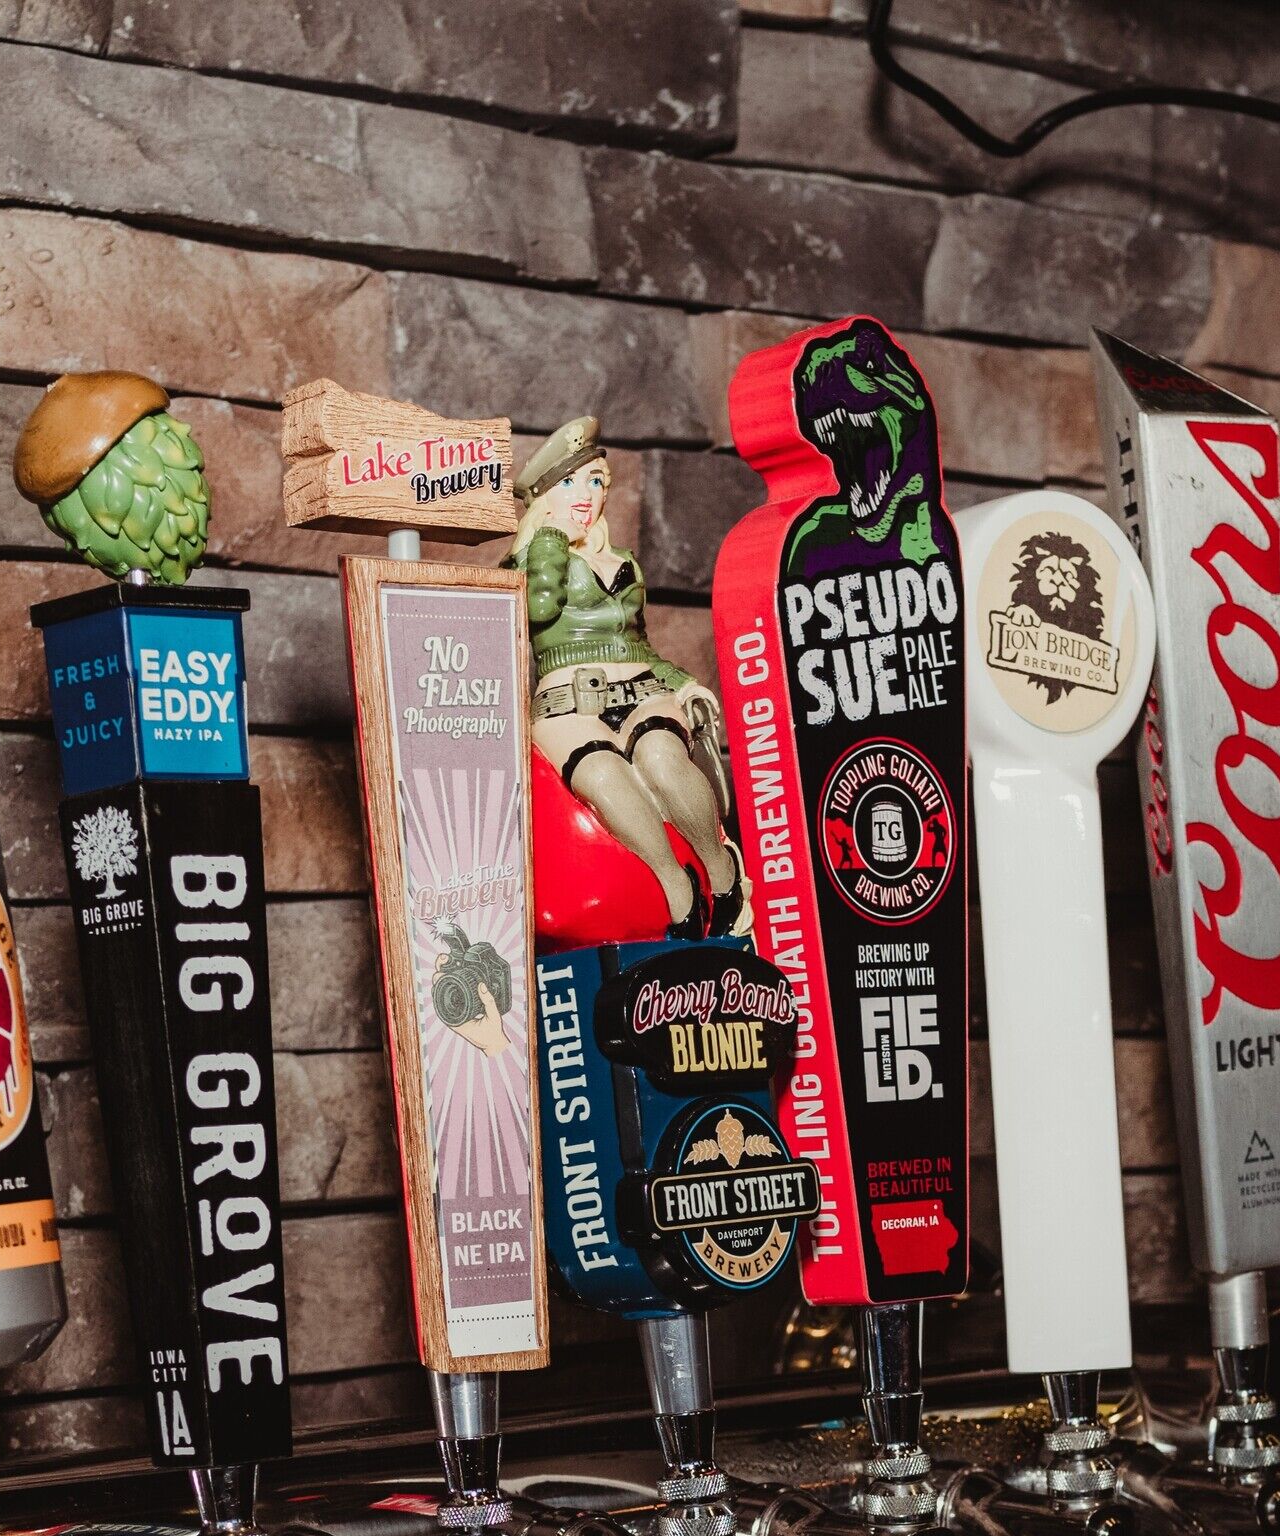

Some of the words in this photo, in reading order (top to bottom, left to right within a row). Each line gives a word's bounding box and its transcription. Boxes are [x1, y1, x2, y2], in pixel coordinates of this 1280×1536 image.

[342, 440, 412, 486] Lake
[417, 436, 495, 471] Time
[411, 462, 503, 504] Brewery
[784, 560, 958, 647] PSEUDO
[140, 648, 232, 685] EASY
[732, 616, 770, 687] CO.
[904, 629, 957, 673] PALE
[1046, 631, 1113, 672] BRIDGE
[54, 654, 120, 688] FRESH
[797, 633, 907, 727] SUE
[1023, 655, 1082, 677] BREWING
[1087, 670, 1106, 684] CO.
[84, 691, 96, 711] &
[908, 669, 948, 711] ALE
[63, 717, 123, 748] JUICY
[154, 727, 192, 741] HAZY
[198, 729, 223, 742] IPA
[403, 706, 507, 740] Photography
[742, 697, 795, 884] BREWING
[830, 753, 886, 814] TOPPLING
[890, 753, 942, 814] GOLIATH
[873, 820, 903, 842] TG
[438, 871, 473, 891] Lake
[474, 861, 513, 881] Time
[855, 872, 913, 908] BREWING
[911, 872, 935, 899] CO.
[82, 907, 101, 925] BIG
[106, 899, 144, 921] GROVE
[413, 874, 519, 919] Brewery
[169, 854, 254, 1012] BIG
[857, 943, 912, 964] BREWING
[914, 942, 931, 962] UP
[855, 969, 902, 989] HISTORY
[905, 966, 935, 987] WITH
[632, 975, 718, 1035] Cherry
[720, 967, 796, 1025] Bomb
[536, 962, 590, 1126] STREET
[669, 1021, 767, 1074] BLONDE
[880, 1033, 892, 1081] MUSEUM
[867, 1159, 932, 1179] BREWED
[936, 1157, 952, 1174] IN
[1237, 1171, 1261, 1183] MADE
[559, 1136, 619, 1273] FRONT
[663, 1178, 732, 1223] FRONT
[734, 1172, 806, 1215] STREET
[868, 1176, 954, 1198] BEAUTIFUL
[185, 1052, 284, 1393] GROVE
[451, 1208, 523, 1234] BLACK
[717, 1225, 764, 1241] DAVENPORT
[881, 1216, 928, 1231] DECORAH,
[928, 1214, 939, 1227] IA
[454, 1243, 483, 1267] NE
[489, 1241, 526, 1264] IPA
[703, 1235, 782, 1278] BREWERY
[731, 1238, 753, 1250] IOWA
[150, 1349, 186, 1365] IOWA
[152, 1367, 187, 1383] CITY
[157, 1390, 195, 1456] IA
